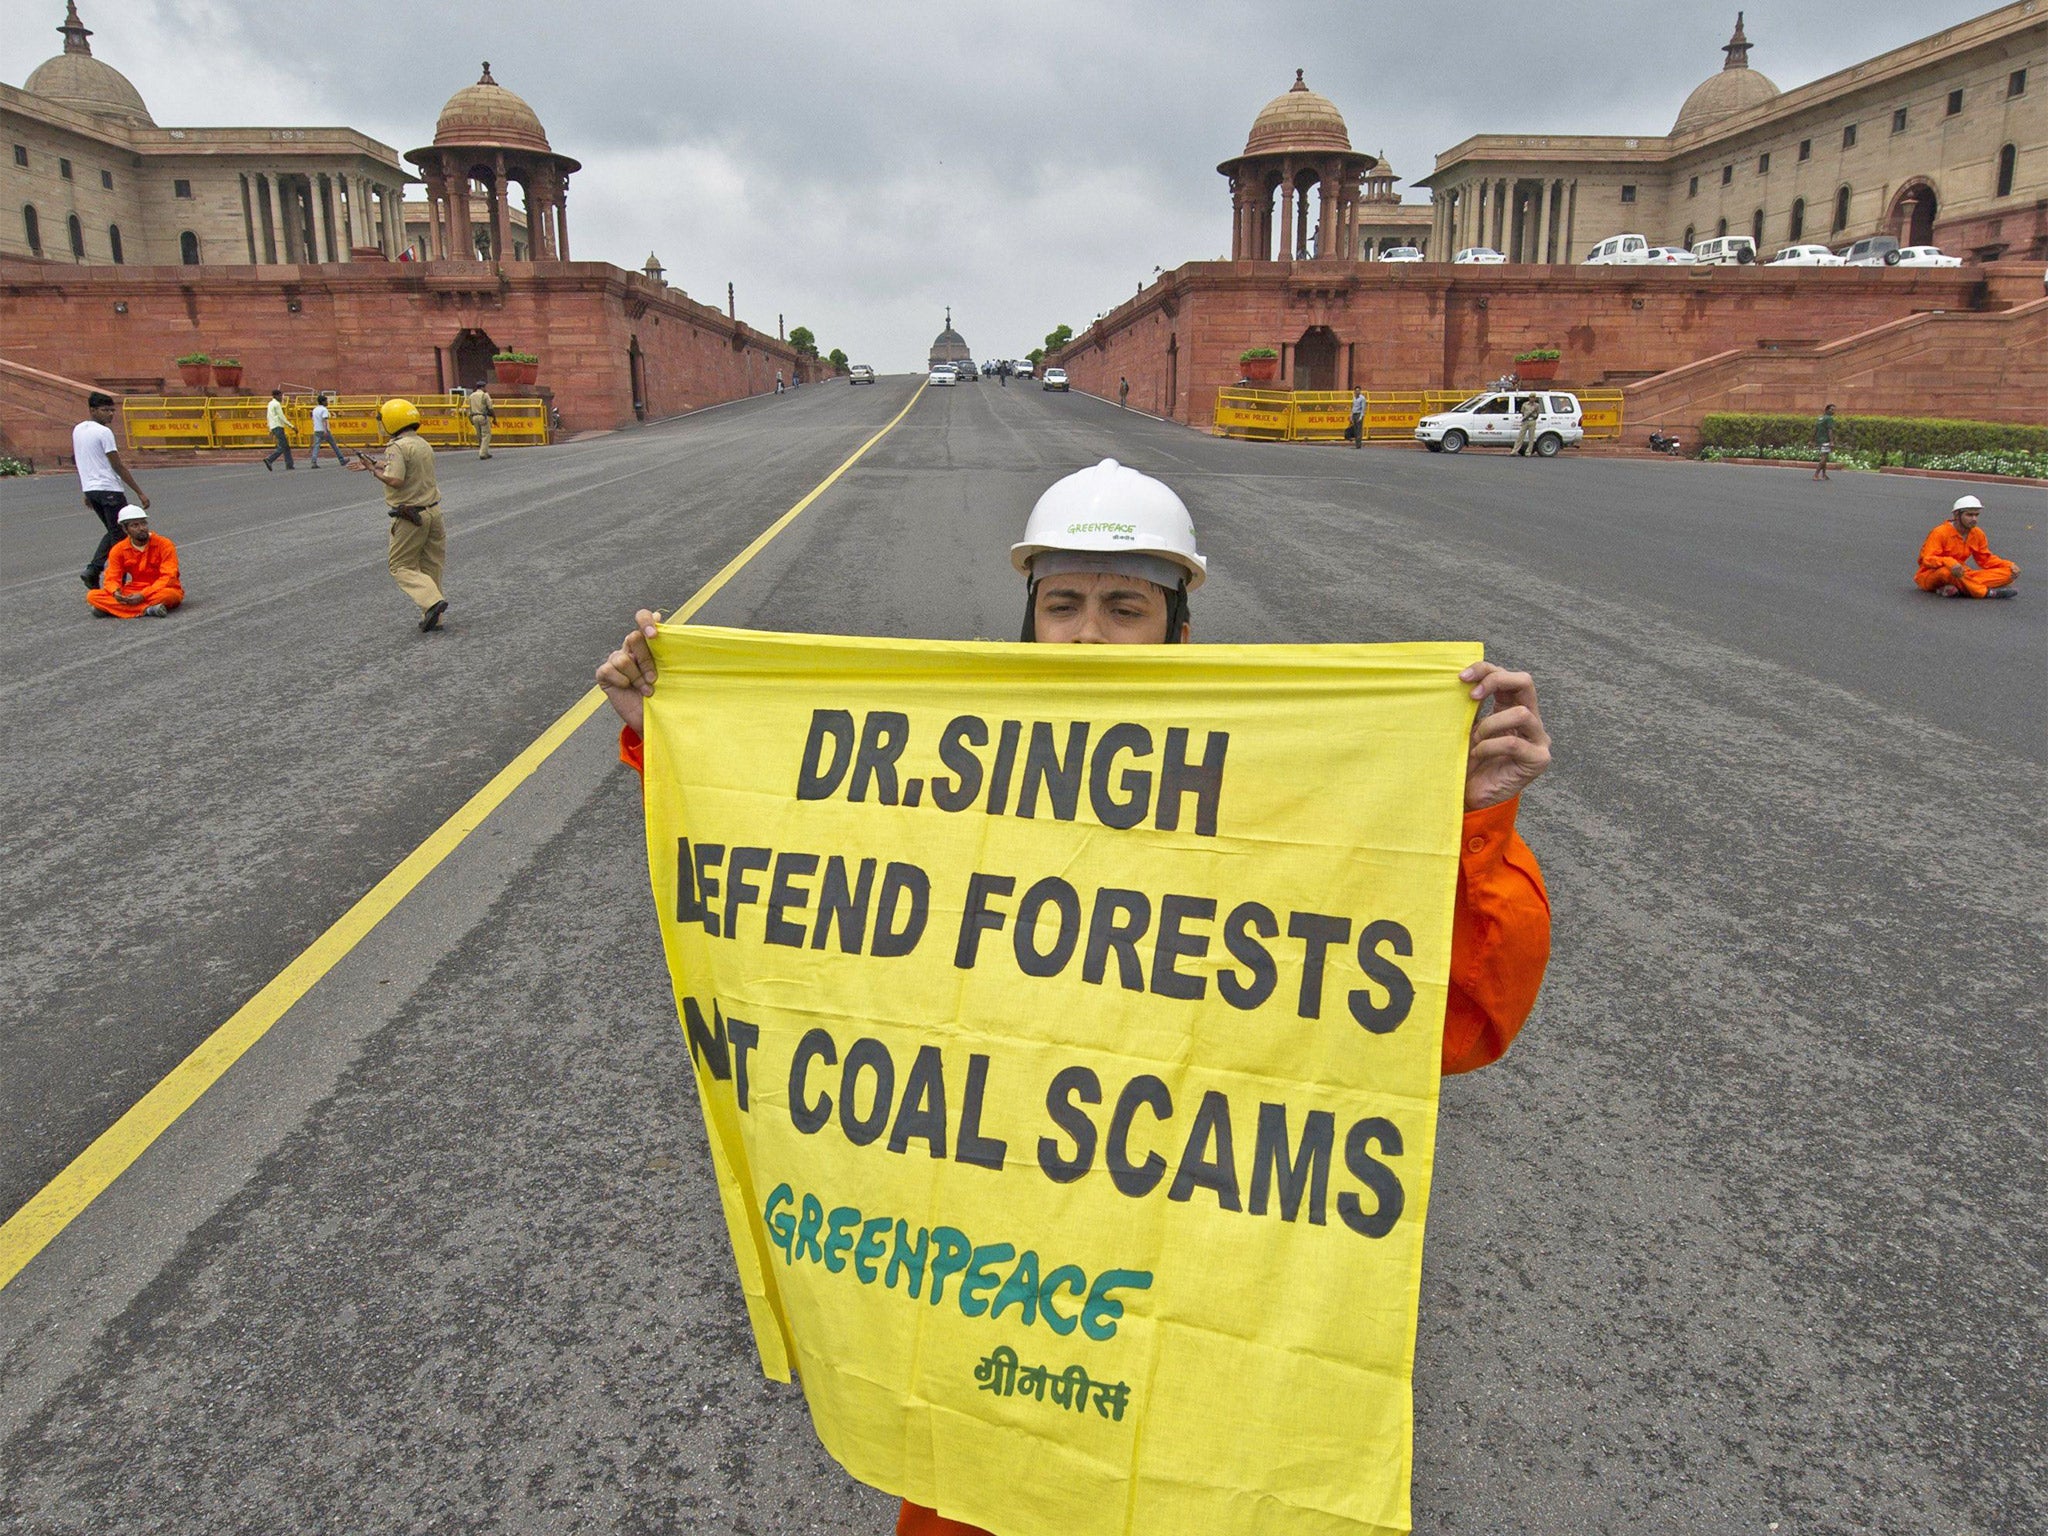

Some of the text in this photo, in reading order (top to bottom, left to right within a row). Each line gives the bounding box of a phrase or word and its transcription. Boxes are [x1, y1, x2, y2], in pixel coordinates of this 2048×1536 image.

[1067, 522, 1136, 534] GREENPEACE
[953, 872, 1416, 1035] FORESTS
[682, 996, 1405, 1239] NT COAL SCAMS
[764, 1182, 1154, 1342] GREENPEACE
[973, 1345, 1131, 1422] ग्रीनपीस
